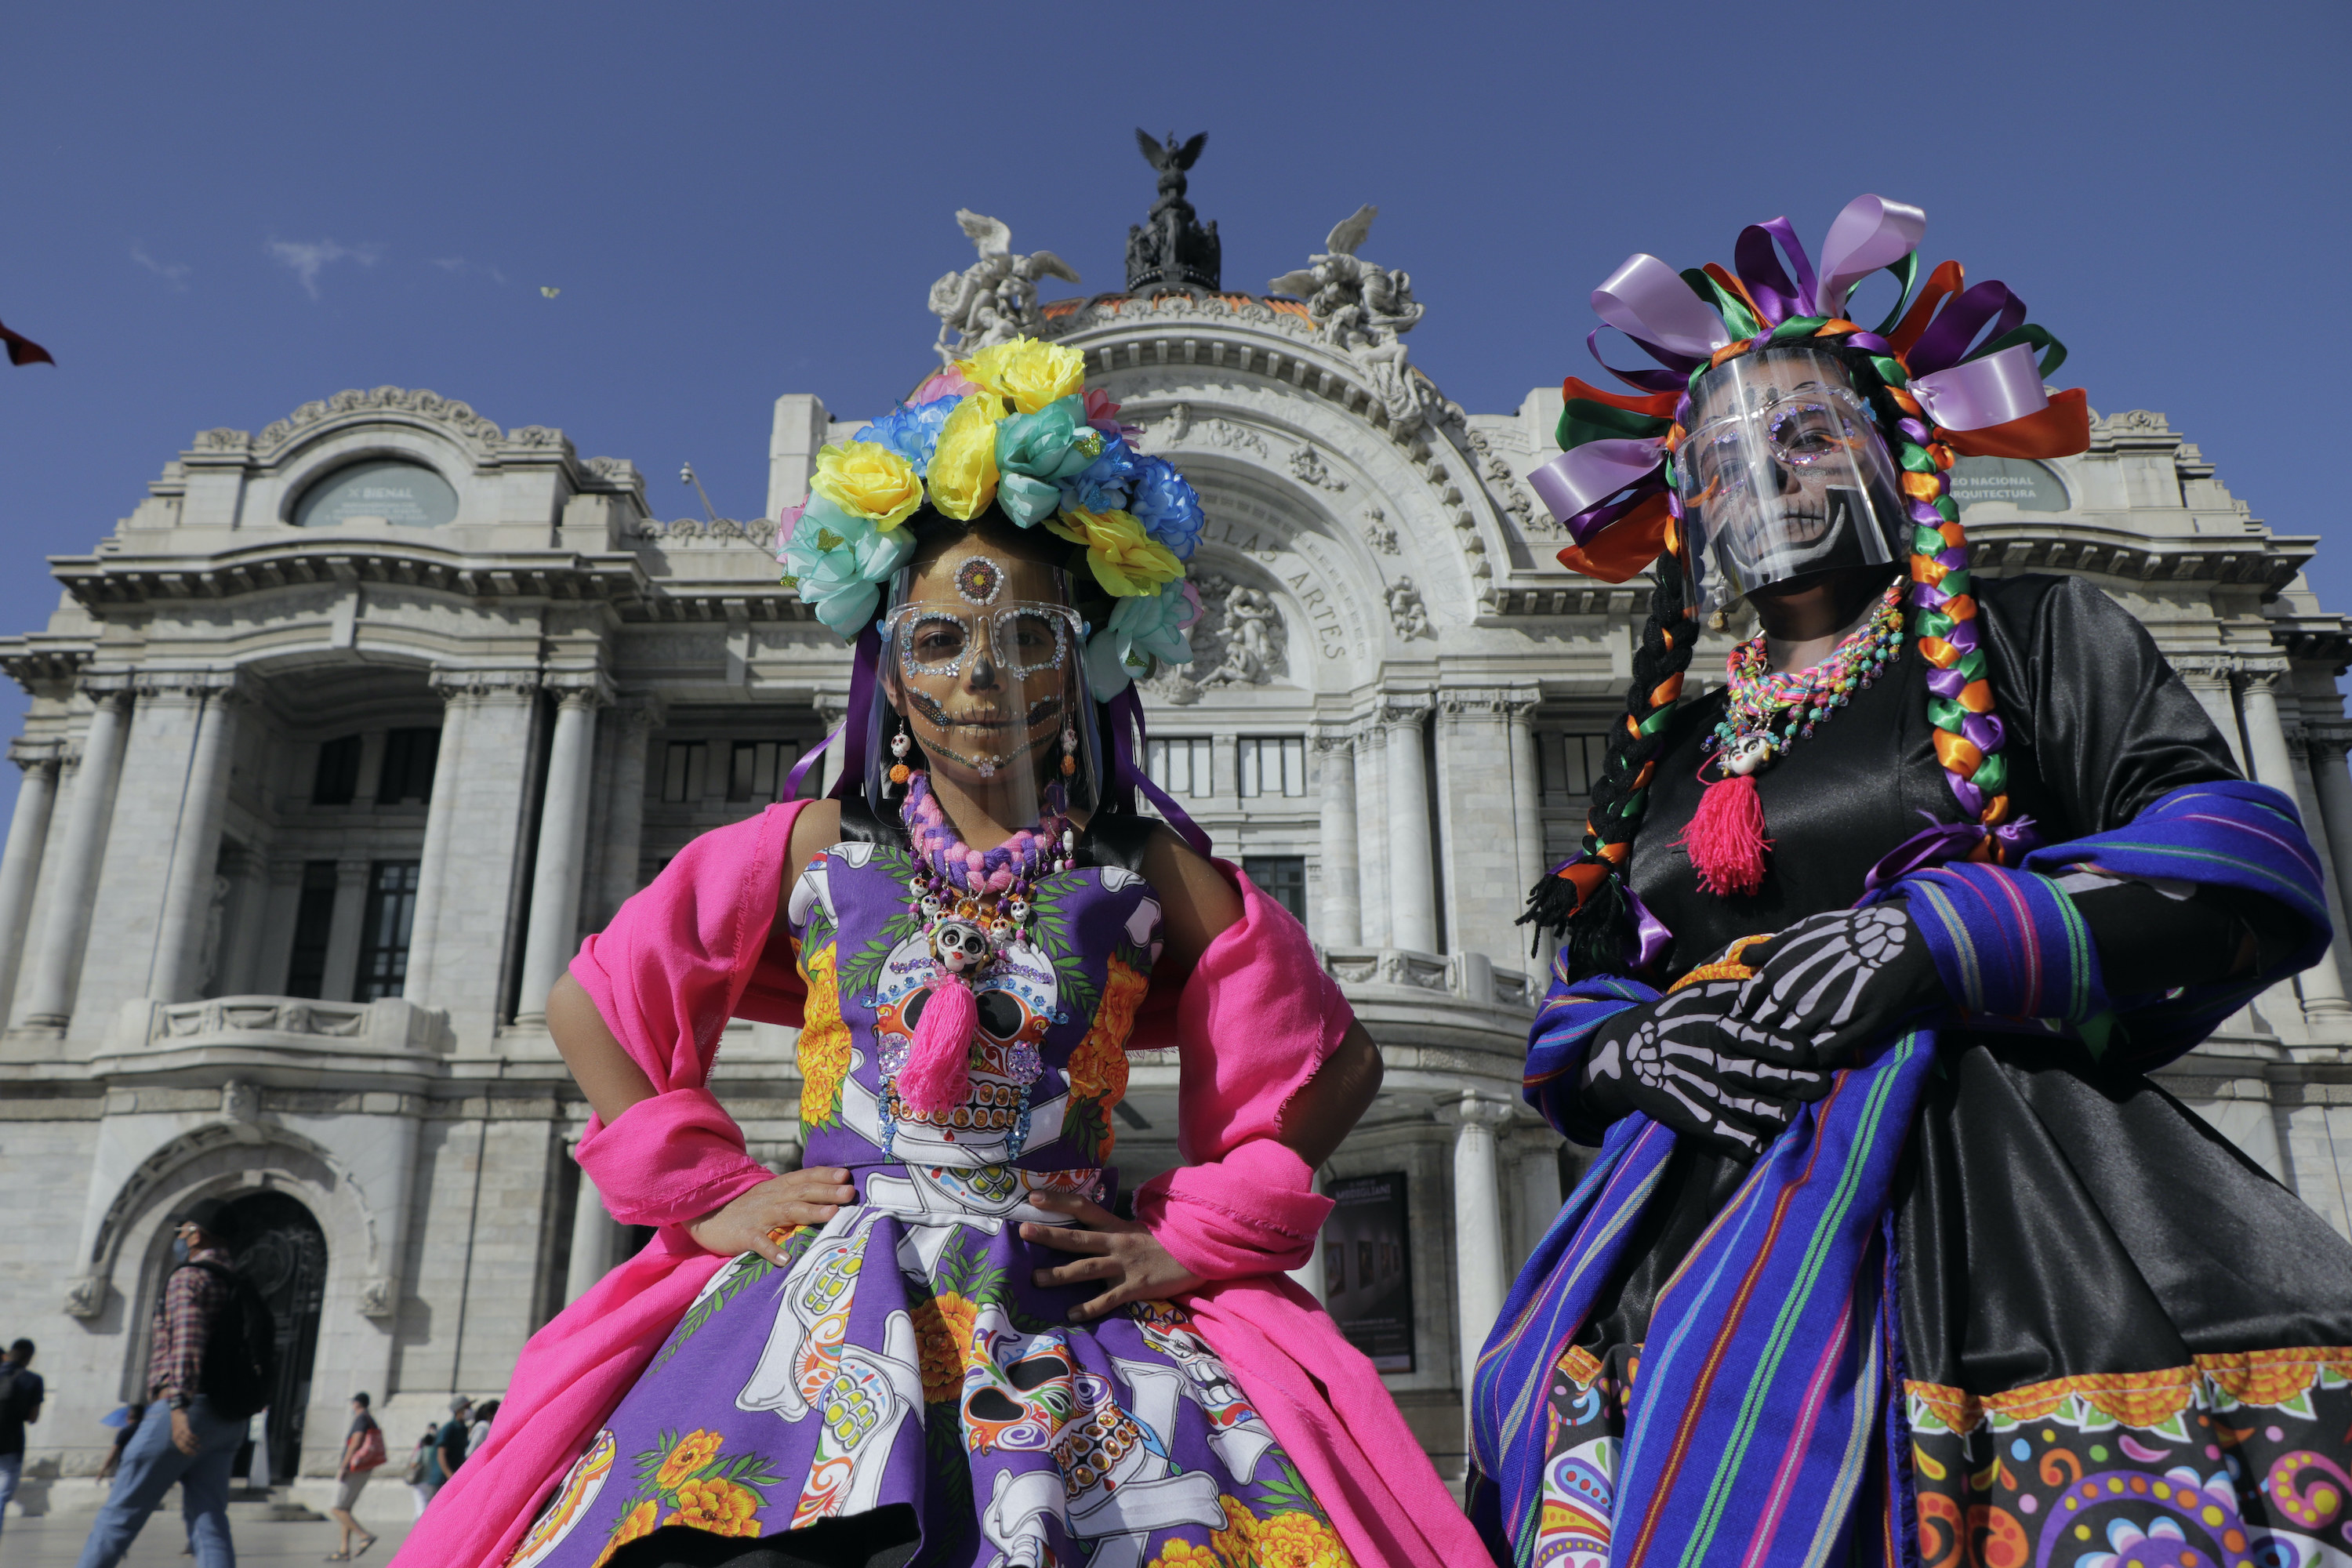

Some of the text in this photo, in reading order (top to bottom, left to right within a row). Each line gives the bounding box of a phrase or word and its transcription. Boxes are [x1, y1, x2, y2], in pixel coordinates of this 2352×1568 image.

[1950, 477, 2034, 486] EO NACIONAL
[363, 488, 413, 498] BIENAL
[1288, 571, 1346, 659] ARTES
[1335, 1184, 1391, 1200] MODIGLIANI
